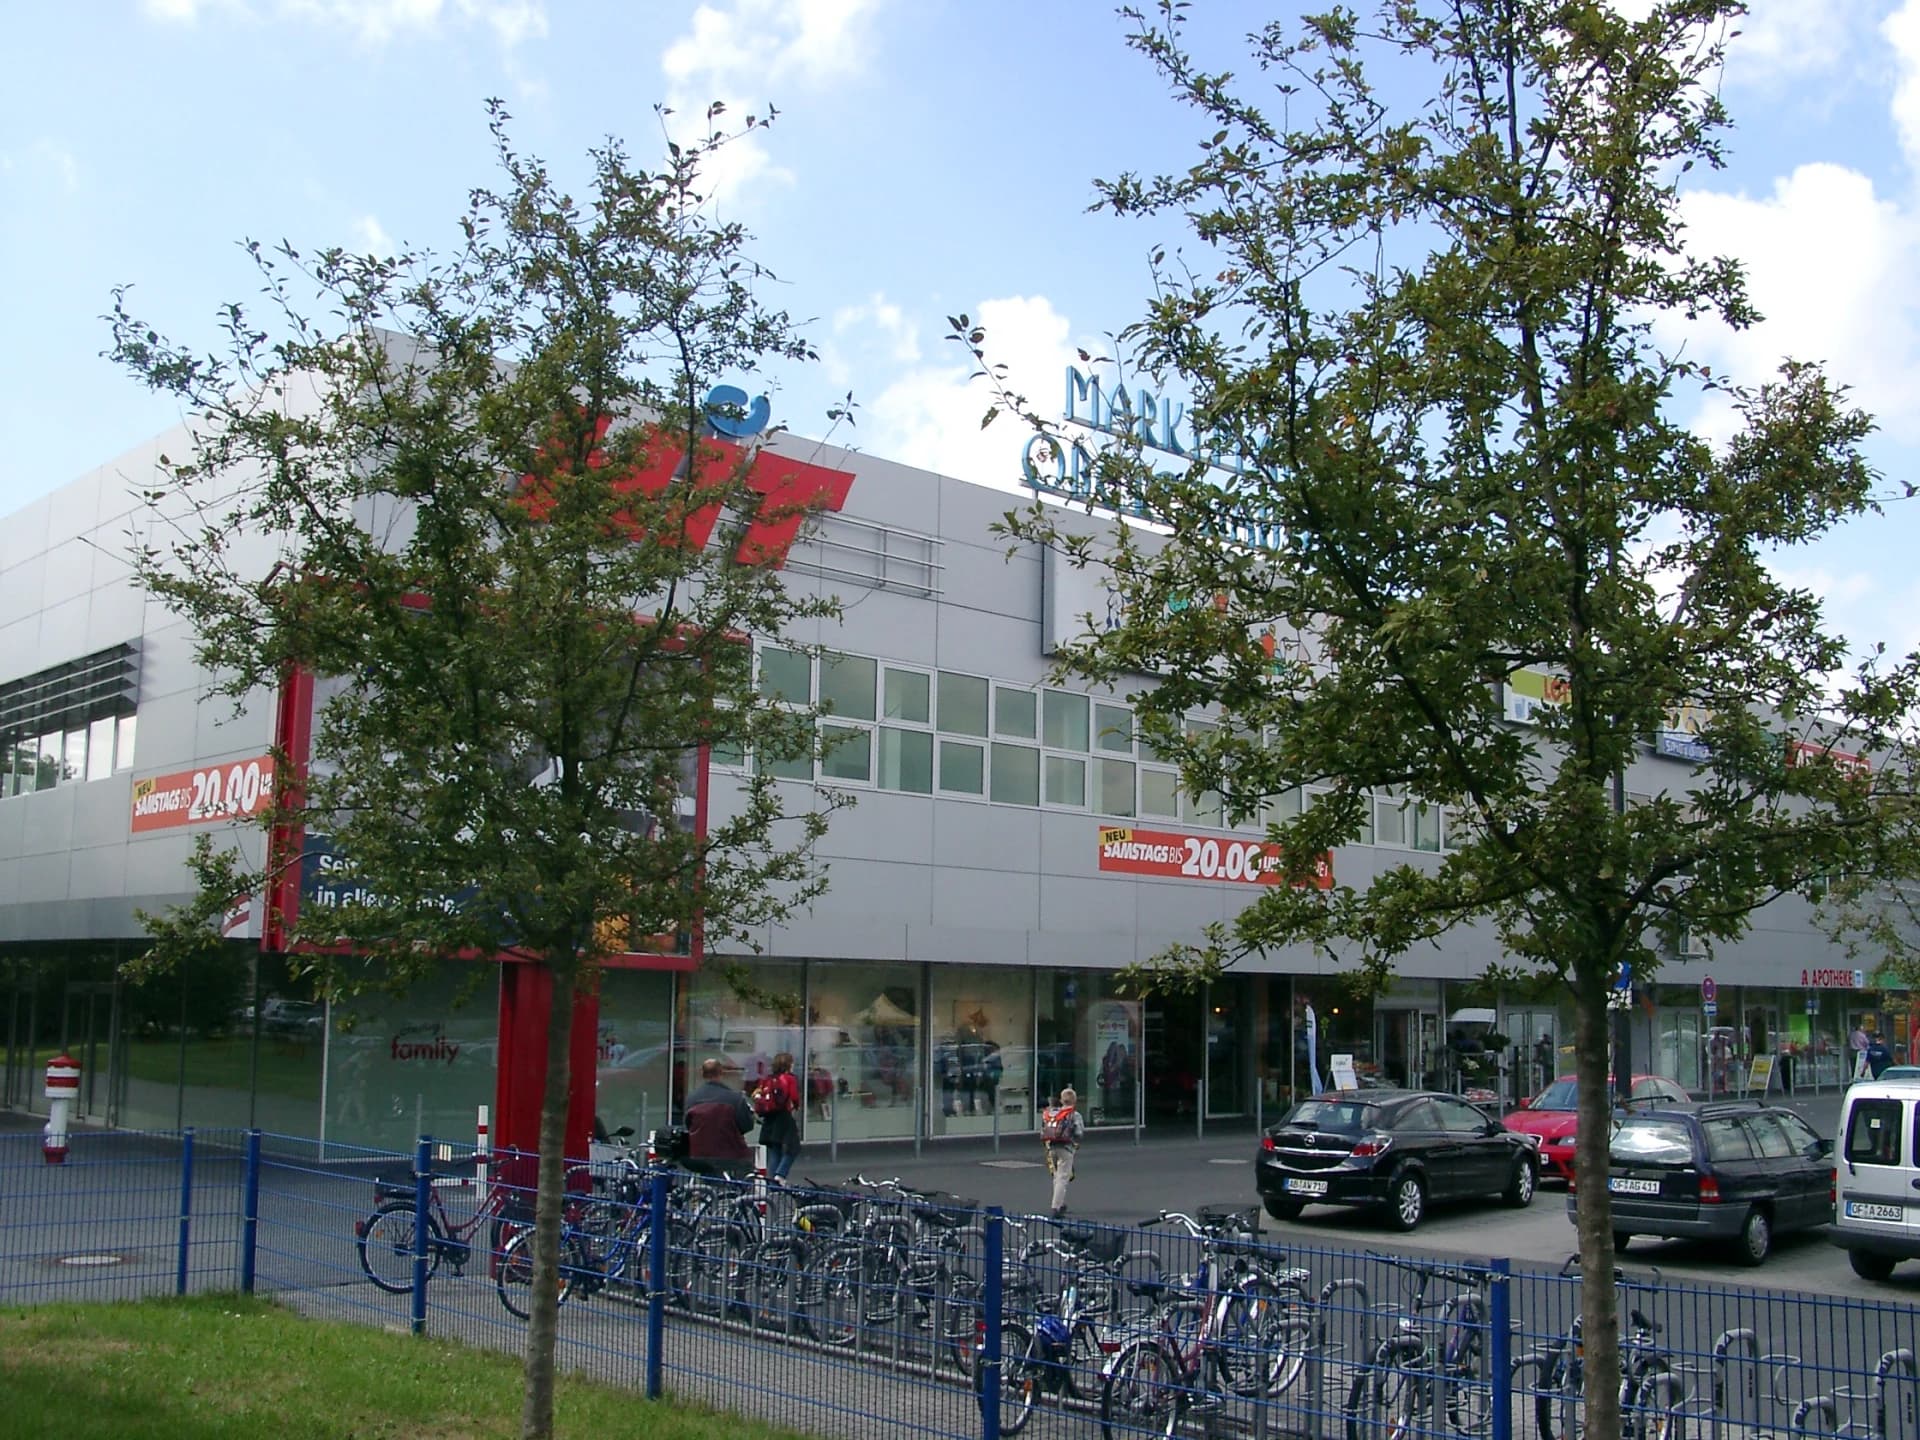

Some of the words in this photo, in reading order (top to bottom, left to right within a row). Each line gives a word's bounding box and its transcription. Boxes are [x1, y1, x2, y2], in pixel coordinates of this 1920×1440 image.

[135, 788, 181, 816] SAMSTAGS
[188, 762, 260, 820] 20.00
[1105, 831, 1126, 842] NEU
[1103, 842, 1169, 863] SAMSTAGS
[1169, 847, 1183, 865] BIS
[1182, 838, 1262, 882] 20.00
[317, 885, 337, 909] in
[1812, 969, 1853, 987] APOTHEKE
[391, 1035, 460, 1066] family
[1852, 1204, 1864, 1214] OF
[1876, 1206, 1901, 1218] 2663
